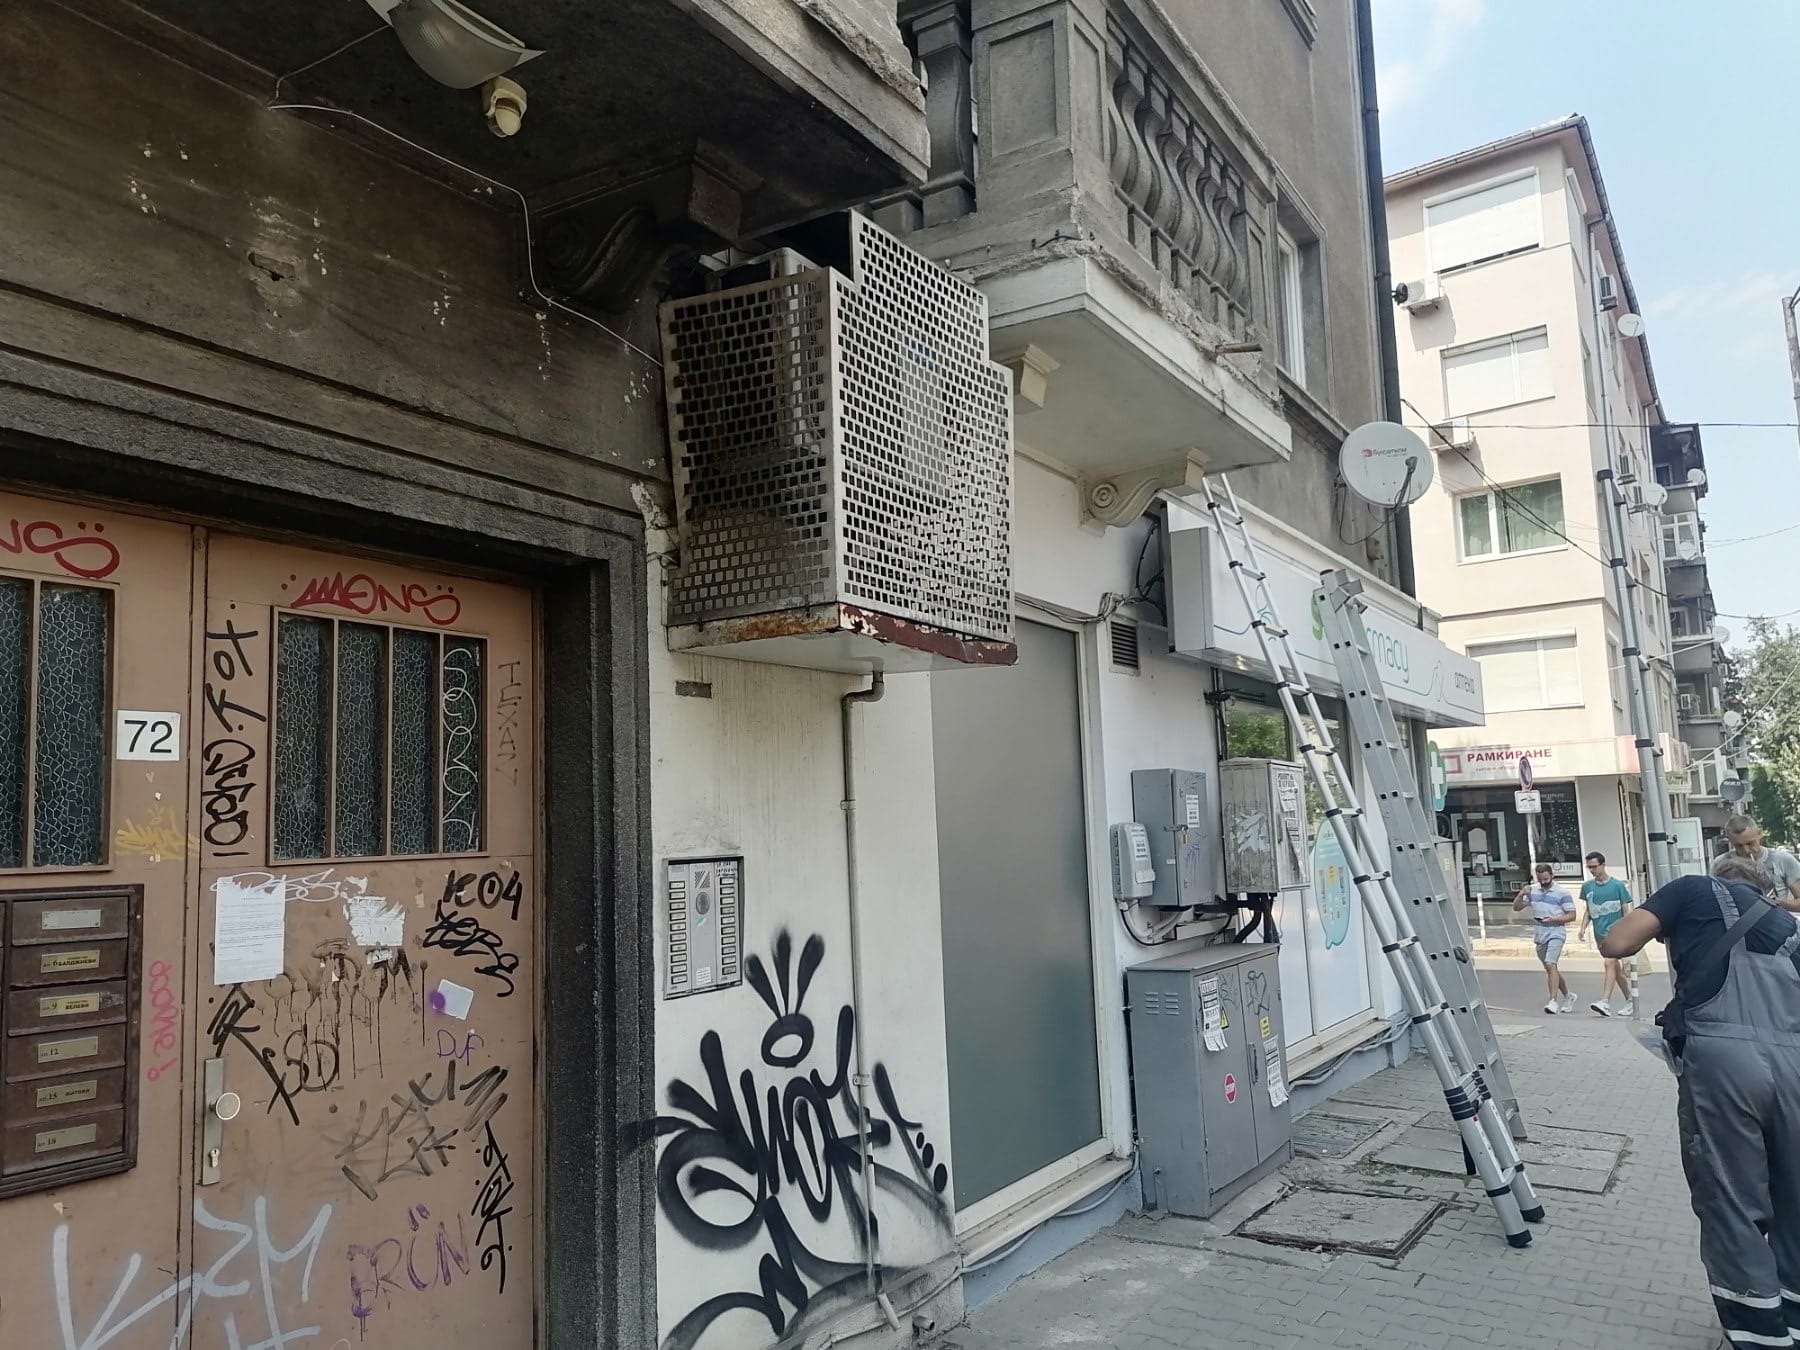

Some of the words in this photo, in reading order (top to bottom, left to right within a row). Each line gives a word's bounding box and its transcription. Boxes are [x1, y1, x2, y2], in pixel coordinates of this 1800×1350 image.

[124, 719, 173, 753] 72
[1467, 748, 1553, 762] РАМКИРАНЕ
[50, 1048, 59, 1056] 12
[49, 1092, 57, 1100] 15
